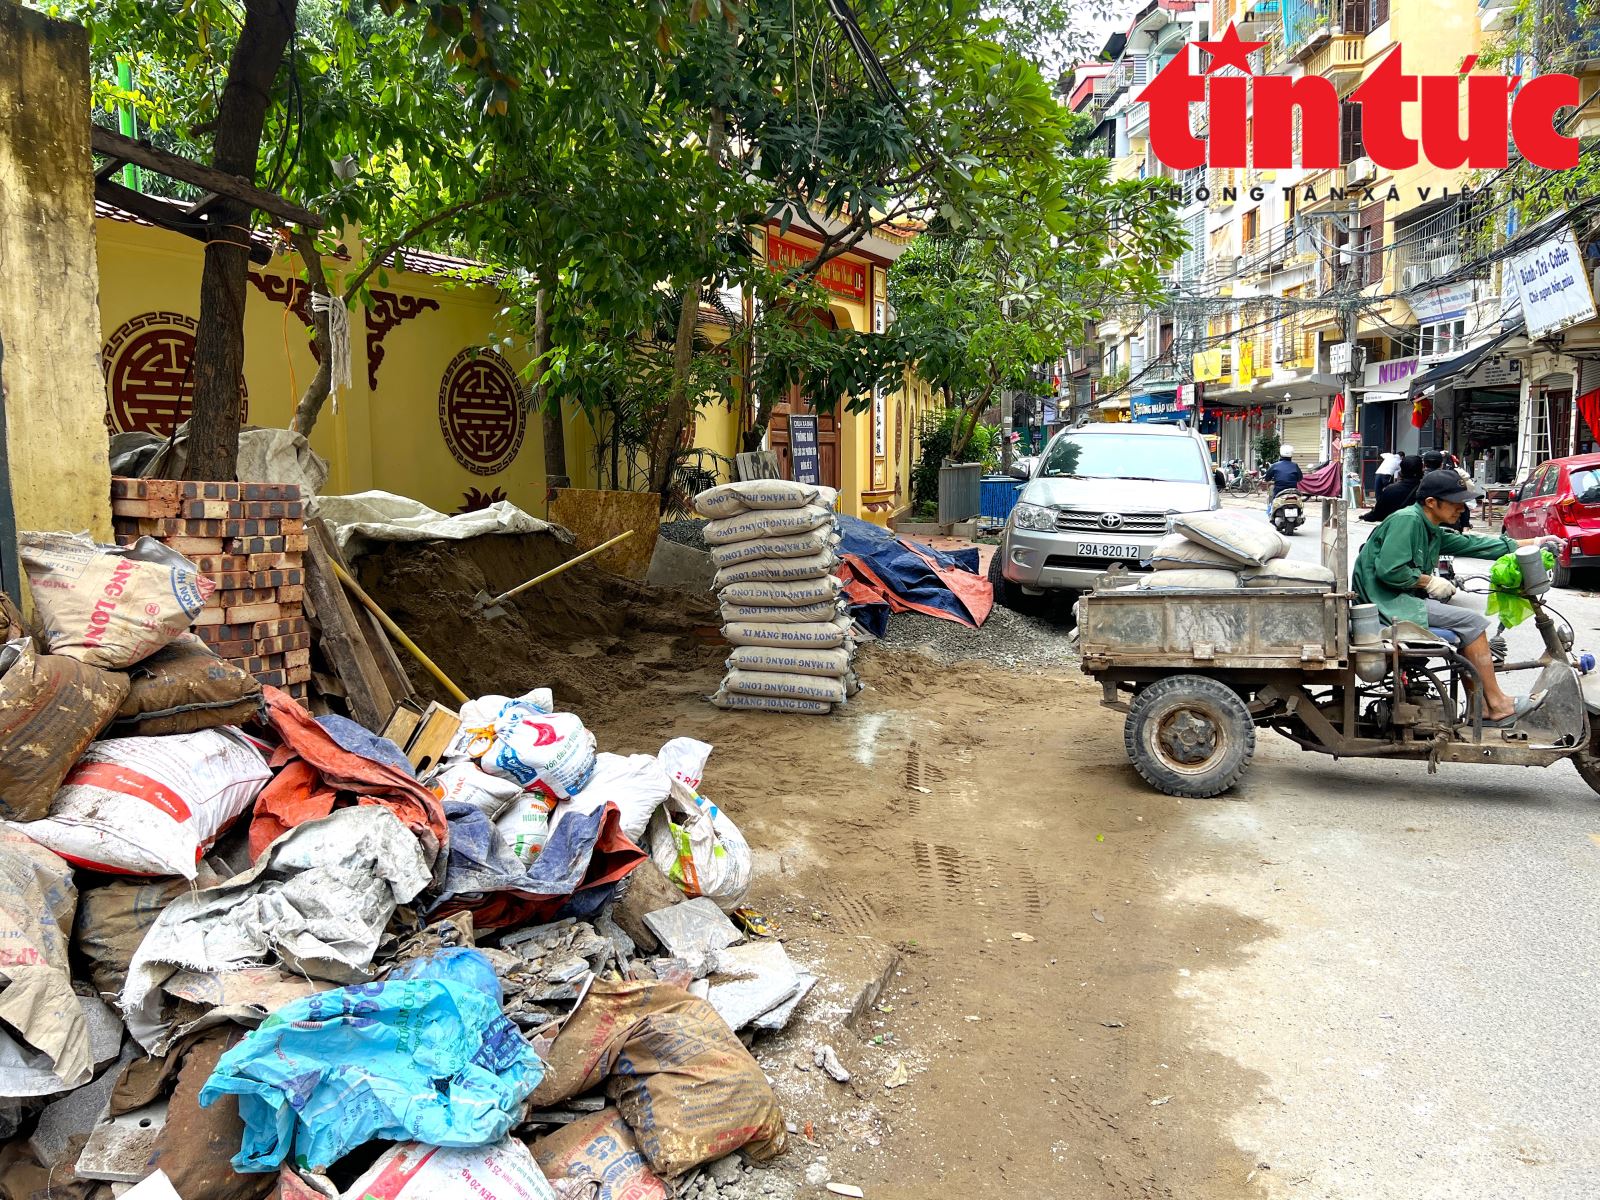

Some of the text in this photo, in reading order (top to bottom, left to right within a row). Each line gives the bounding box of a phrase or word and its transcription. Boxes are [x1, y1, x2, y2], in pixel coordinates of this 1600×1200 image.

[1078, 543, 1138, 558] 29A-820.12
[814, 633, 837, 641] LONG
[739, 655, 763, 664] LONG
[738, 681, 762, 690] LONG
[797, 701, 821, 709] LONG
[470, 1179, 482, 1190] 20
